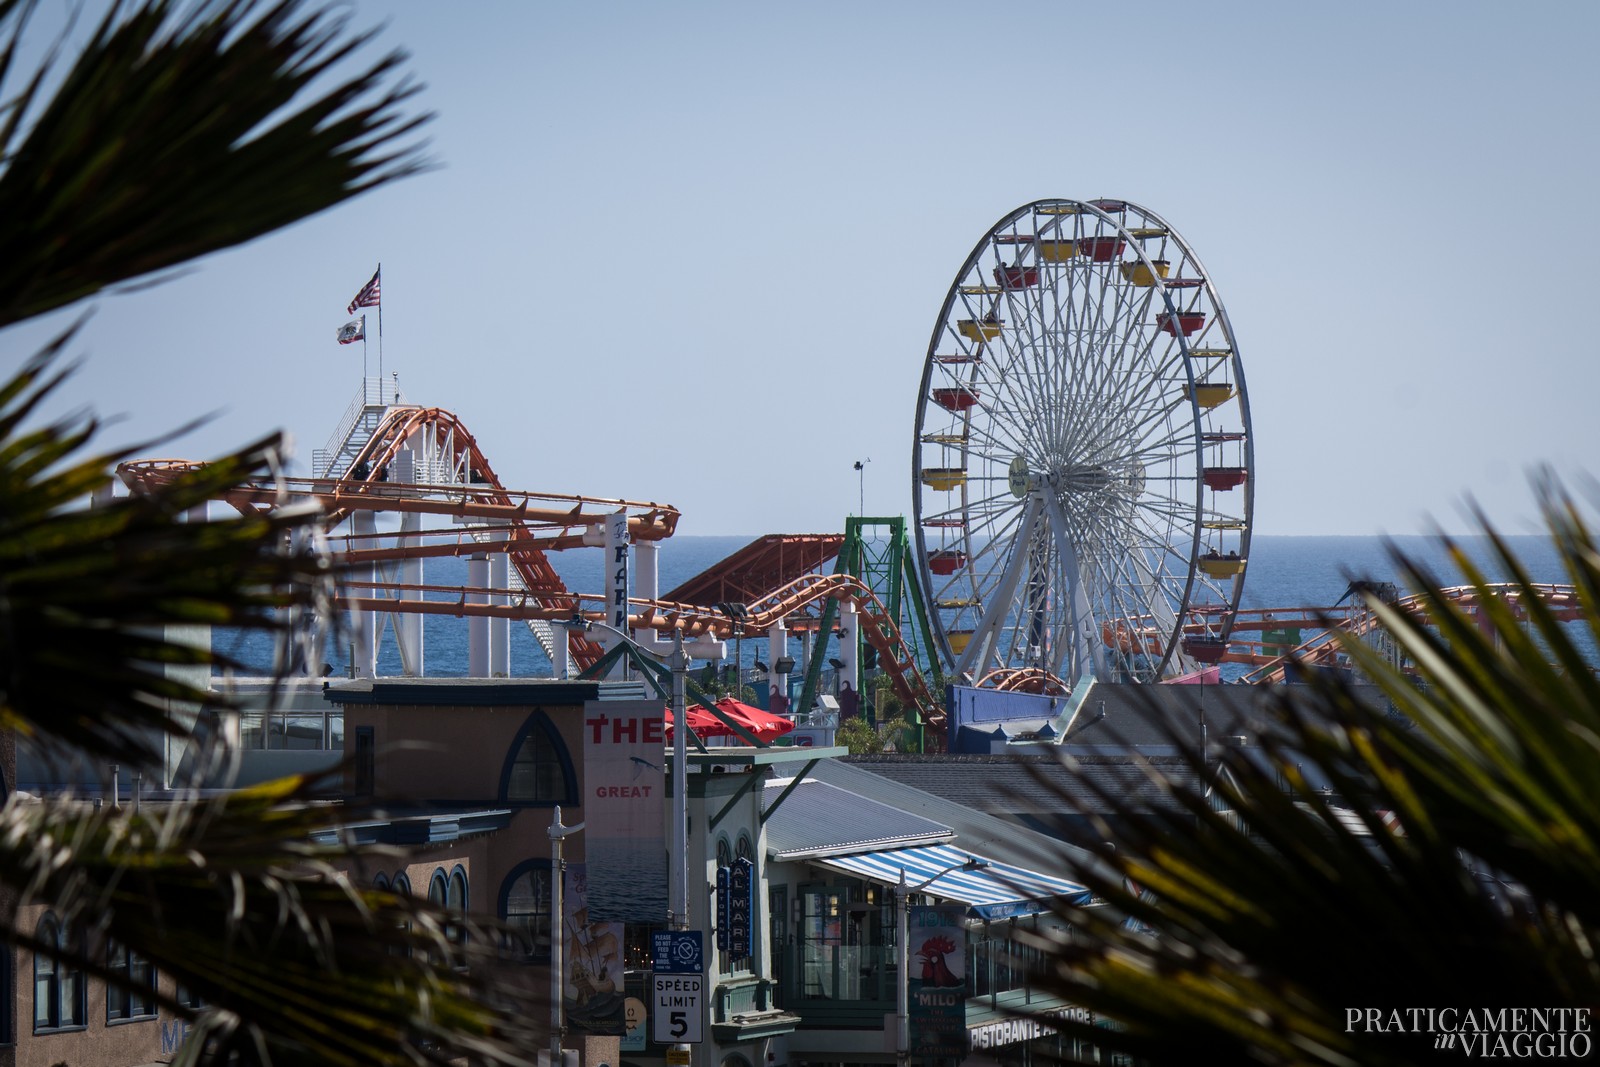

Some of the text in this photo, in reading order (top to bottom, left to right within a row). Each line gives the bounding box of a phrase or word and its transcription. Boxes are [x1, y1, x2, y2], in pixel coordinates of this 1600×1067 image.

[586, 715, 663, 744] THE
[596, 785, 652, 798] GREAT
[918, 911, 957, 928] 1912
[656, 981, 700, 991] SPEED
[660, 996, 697, 1008] LIMIT
[669, 1011, 689, 1036] 5
[970, 1018, 1041, 1052] RISTORANTE
